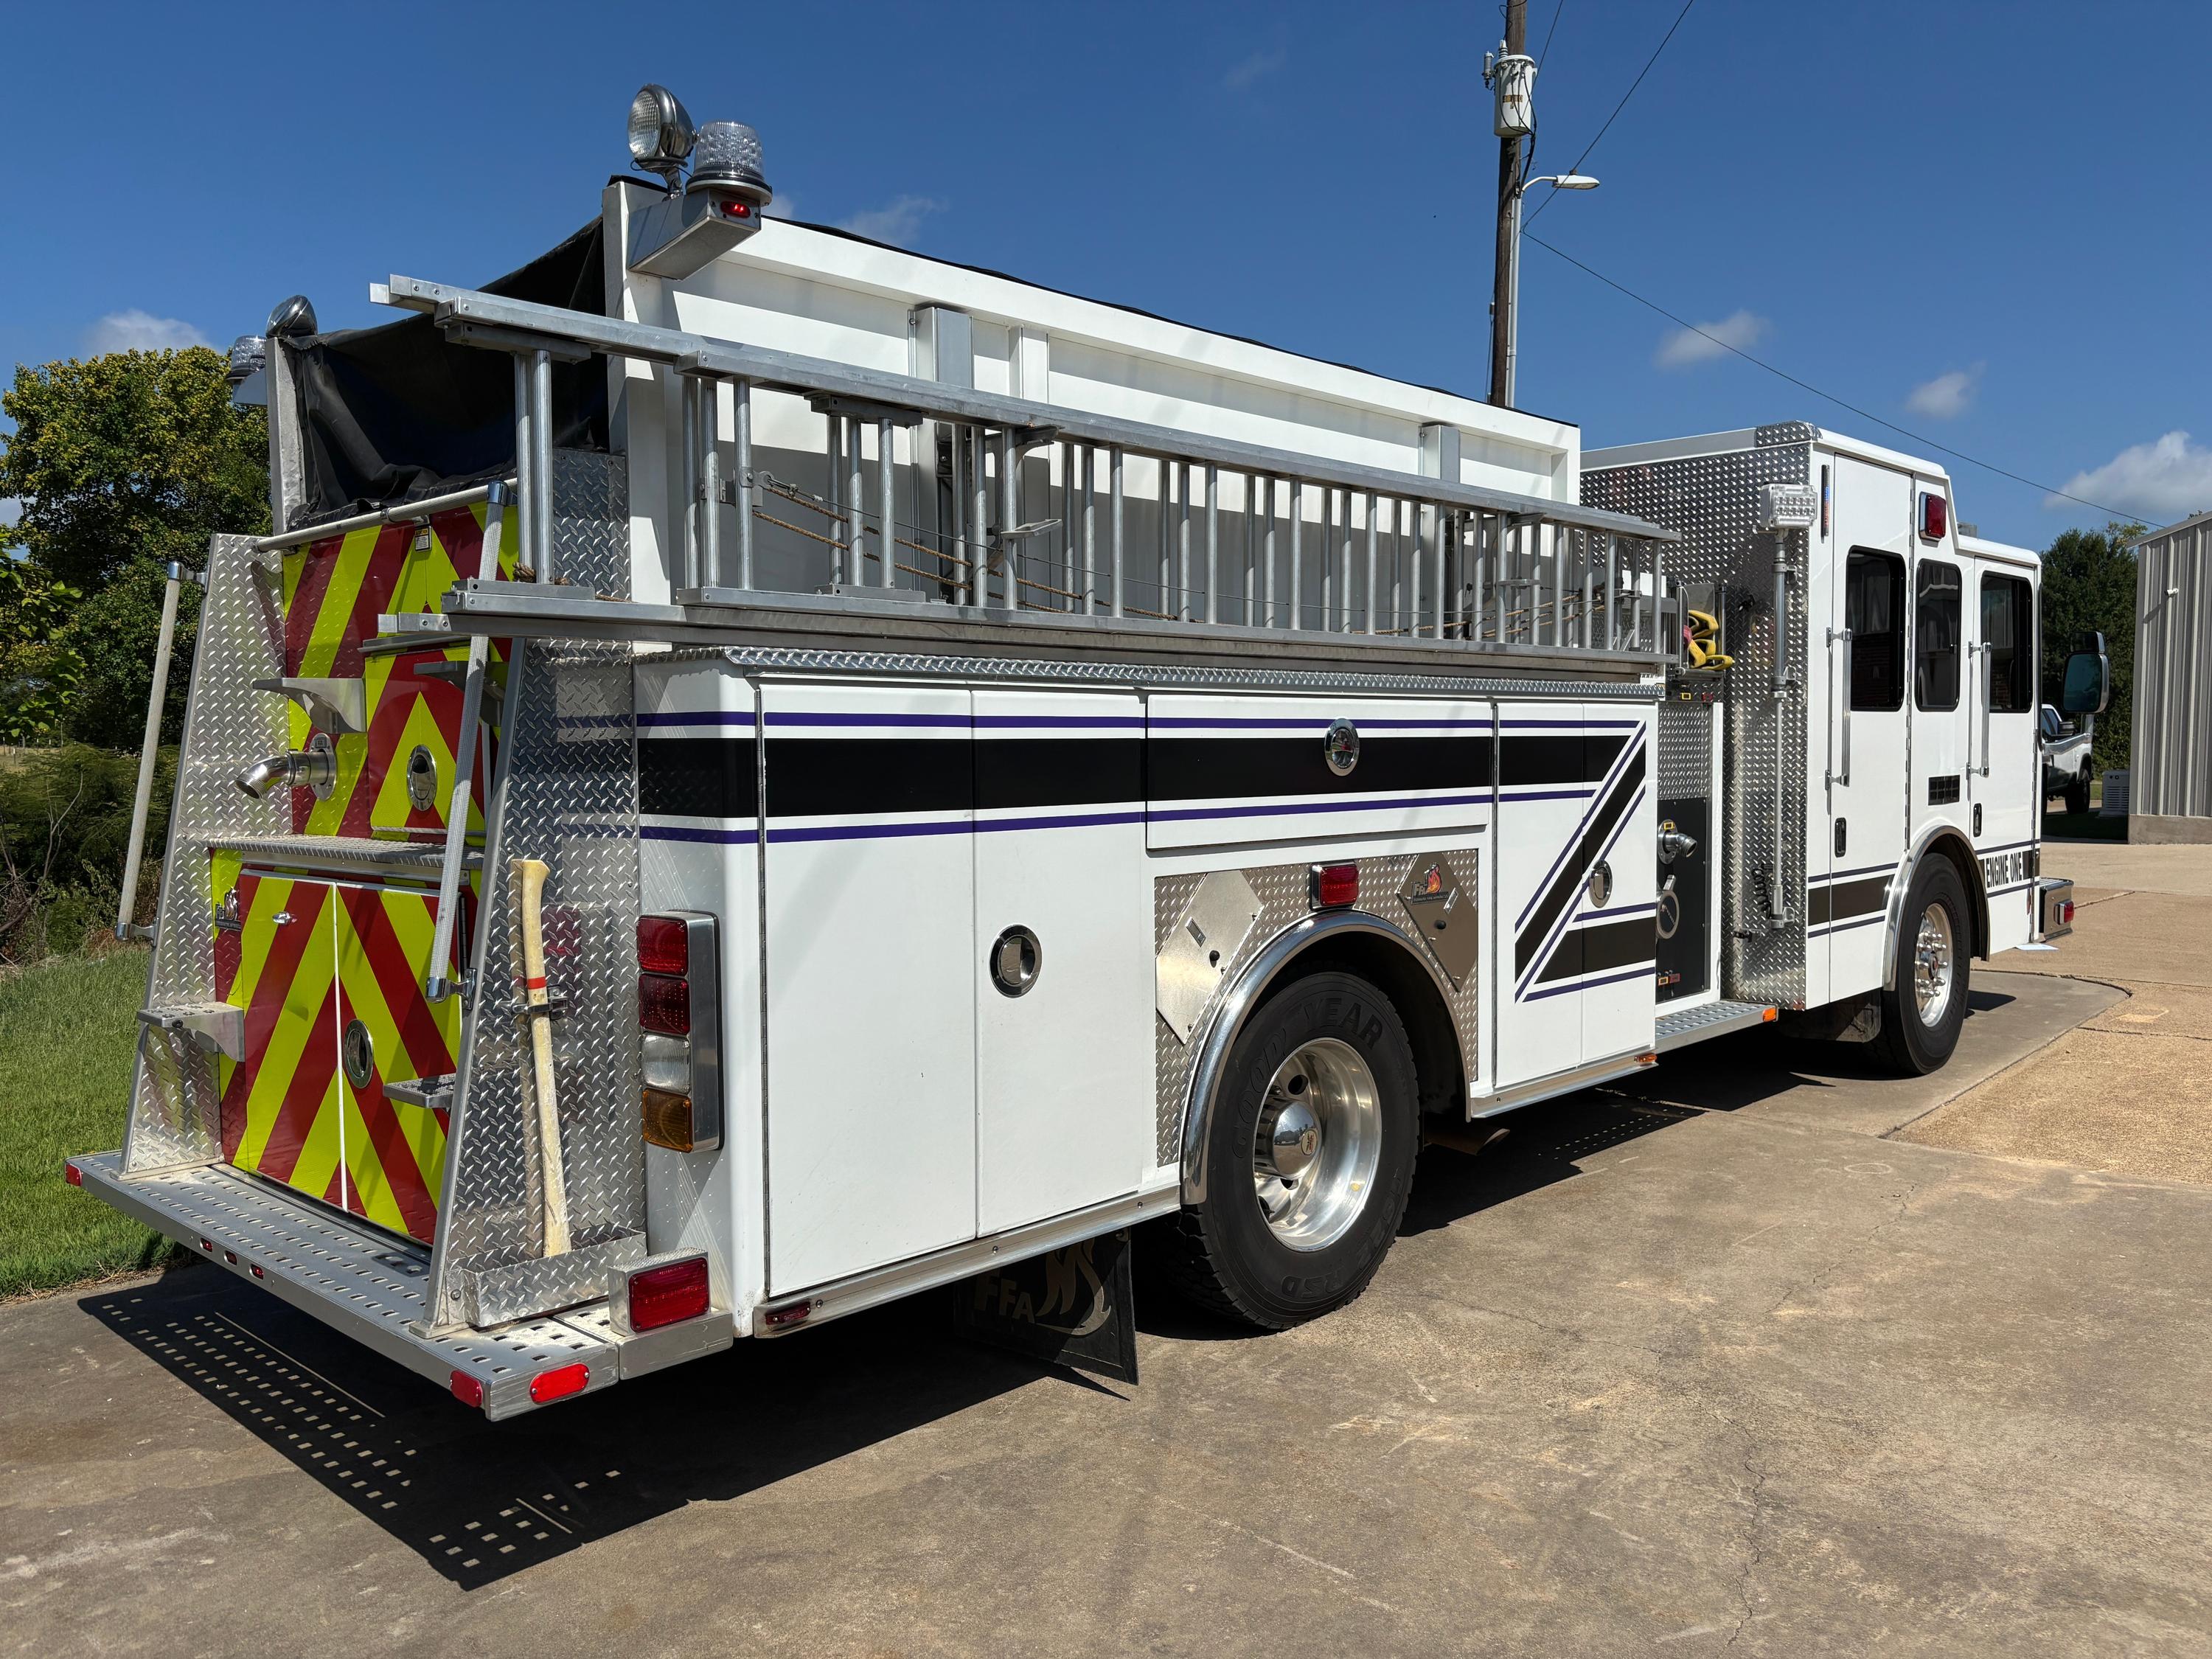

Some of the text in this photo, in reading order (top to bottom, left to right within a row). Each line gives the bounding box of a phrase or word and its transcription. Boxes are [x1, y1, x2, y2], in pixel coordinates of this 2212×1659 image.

[1986, 852, 2022, 888] ENGINE ONE
[973, 1269, 1036, 1324] FFA
